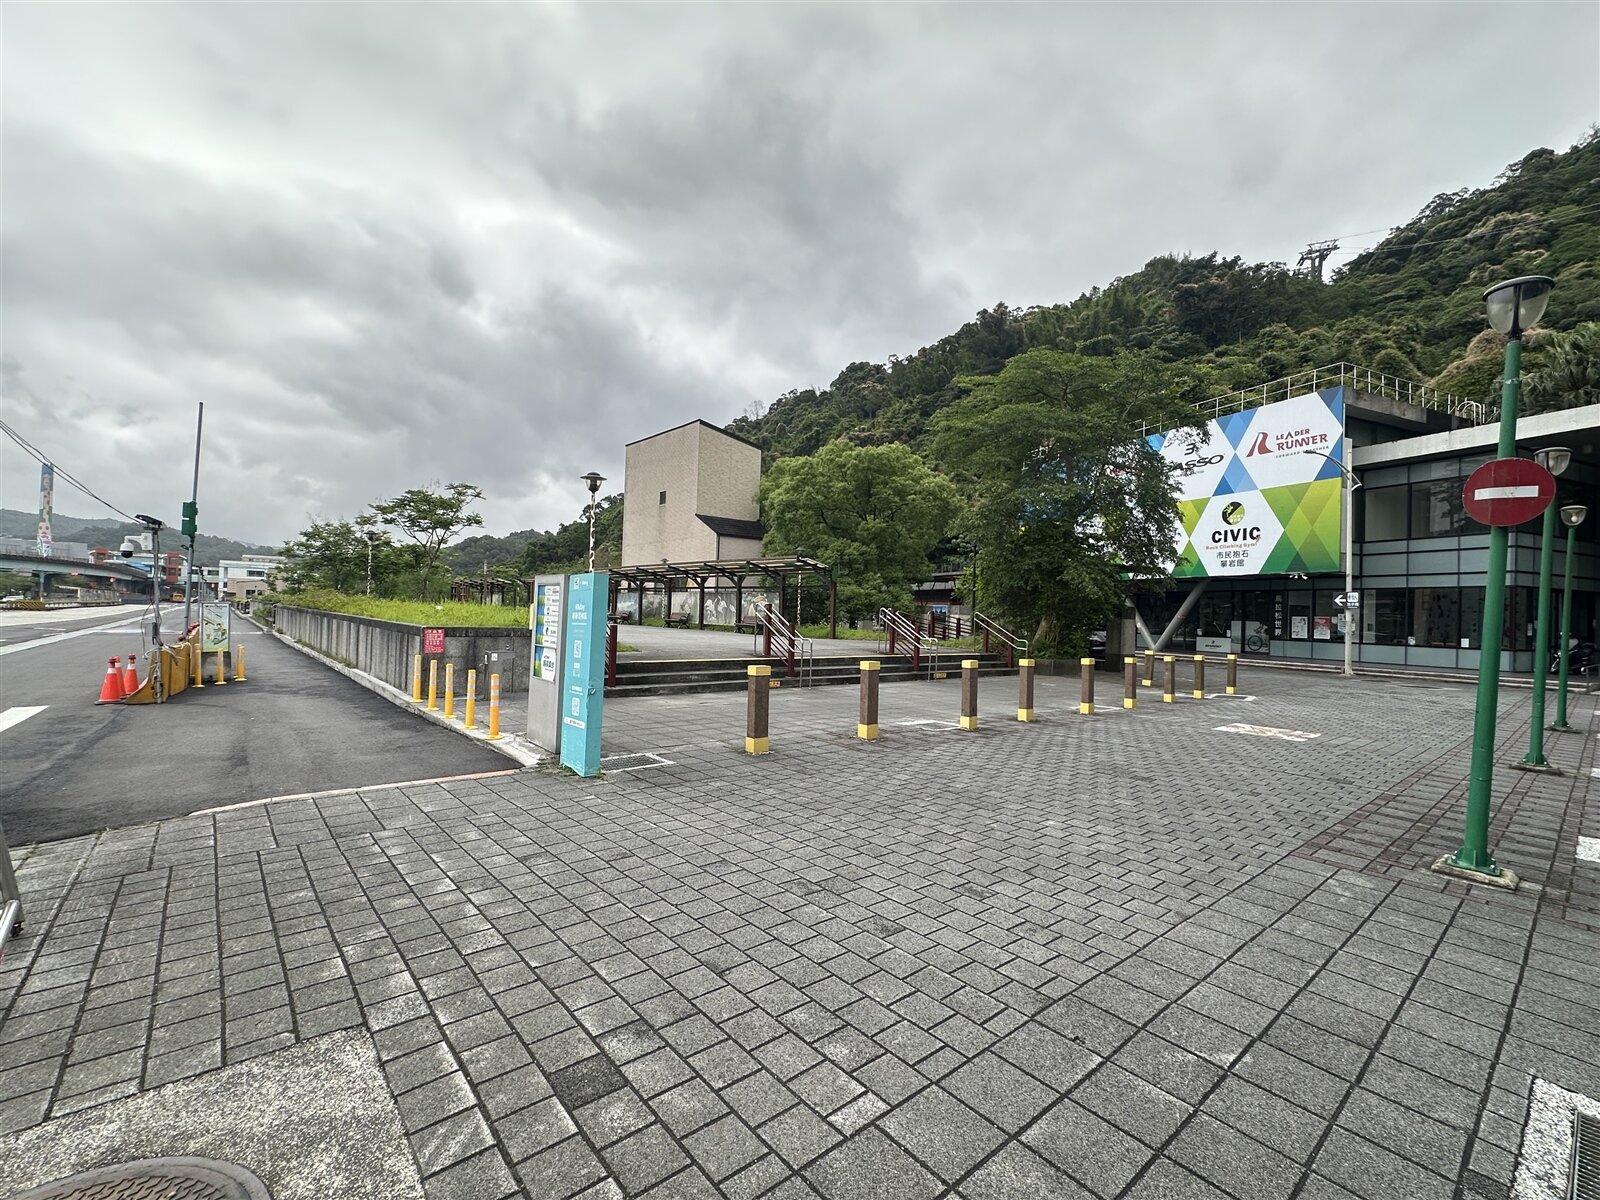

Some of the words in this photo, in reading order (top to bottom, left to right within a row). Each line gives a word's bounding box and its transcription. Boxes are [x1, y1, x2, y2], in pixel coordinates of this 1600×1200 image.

[1276, 428, 1310, 441] LEADER
[1277, 433, 1328, 452] RUNNER
[1211, 526, 1261, 544] CIVIC
[1220, 542, 1242, 550] Climbing
